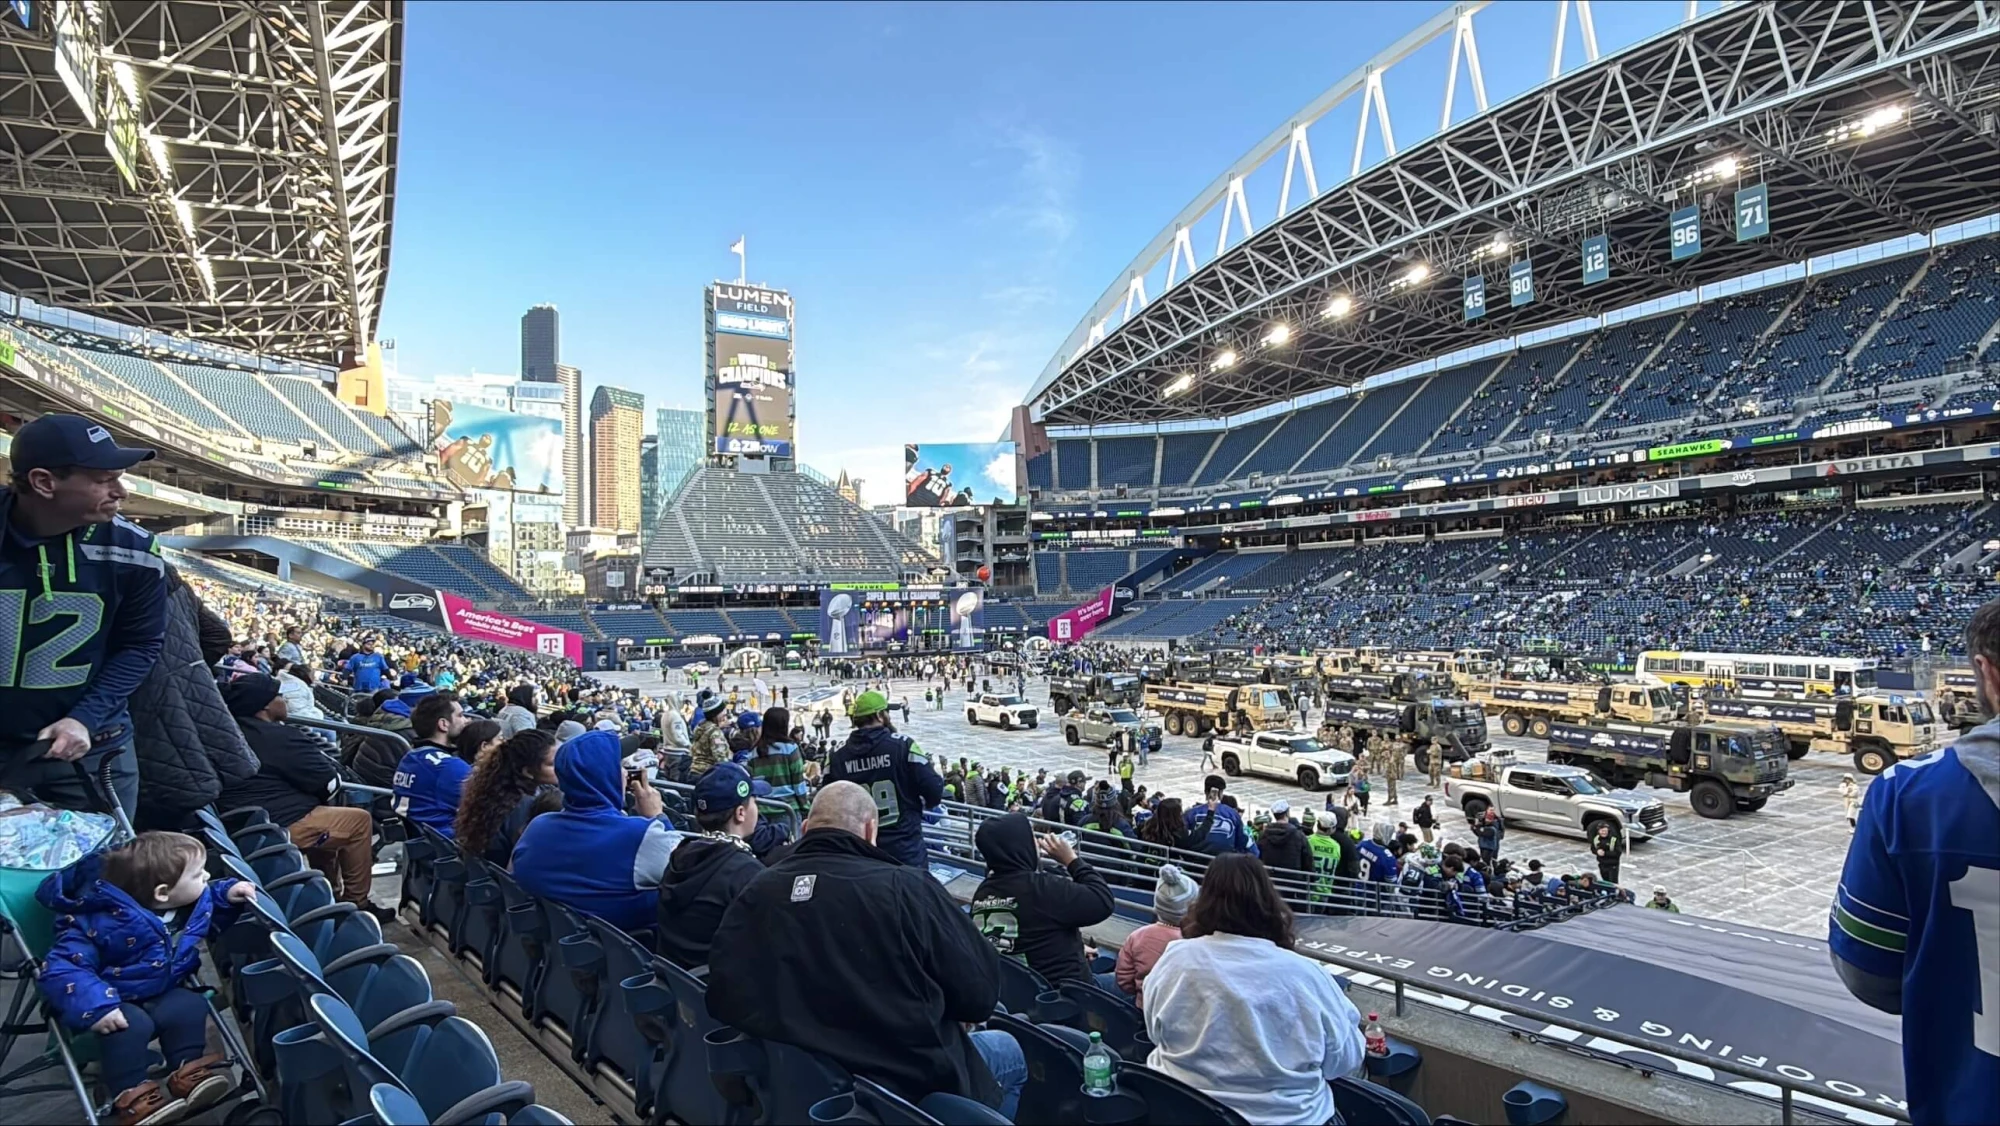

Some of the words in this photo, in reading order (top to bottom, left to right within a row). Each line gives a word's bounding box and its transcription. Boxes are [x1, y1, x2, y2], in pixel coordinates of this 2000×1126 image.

[1740, 205, 1764, 228] 71
[1673, 225, 1698, 247] 96
[1586, 253, 1605, 273] 12
[1512, 276, 1531, 296] 80
[716, 285, 789, 306] LUMEN
[1465, 291, 1483, 309] 45
[736, 302, 768, 313] FIELD
[718, 365, 786, 390] CHAMPIONS
[727, 422, 741, 433] 12
[741, 423, 757, 435] AS
[759, 425, 780, 436] ONE
[1656, 442, 1713, 457] SEAHAWKS
[1846, 456, 1914, 473] DELTA
[1732, 471, 1755, 481] aws
[925, 475, 947, 497] 10
[1584, 483, 1670, 503] LUMEN
[1507, 496, 1544, 507] BECU
[645, 585, 666, 595] 0:00
[866, 591, 884, 601] SUPER
[885, 591, 900, 601] BOWL
[910, 591, 941, 601] CHAMPIONS
[1079, 611, 1093, 622] over
[1093, 605, 1105, 617] here
[1086, 599, 1104, 614] better
[456, 608, 510, 629] America's
[510, 621, 536, 634] Best
[1060, 622, 1068, 635] T
[491, 624, 523, 637] Network
[0, 589, 105, 690] 12
[543, 638, 559, 653] T
[742, 652, 760, 669] 12
[844, 754, 891, 774] WILLIAMS
[860, 779, 900, 827] 9
[1358, 858, 1371, 881] 9
[1408, 869, 1420, 880] 31
[794, 886, 811, 896] ICON
[1426, 965, 1574, 1010] SIDING
[1592, 1006, 1620, 1022] &
[1639, 1020, 1909, 1111] ROOFING
